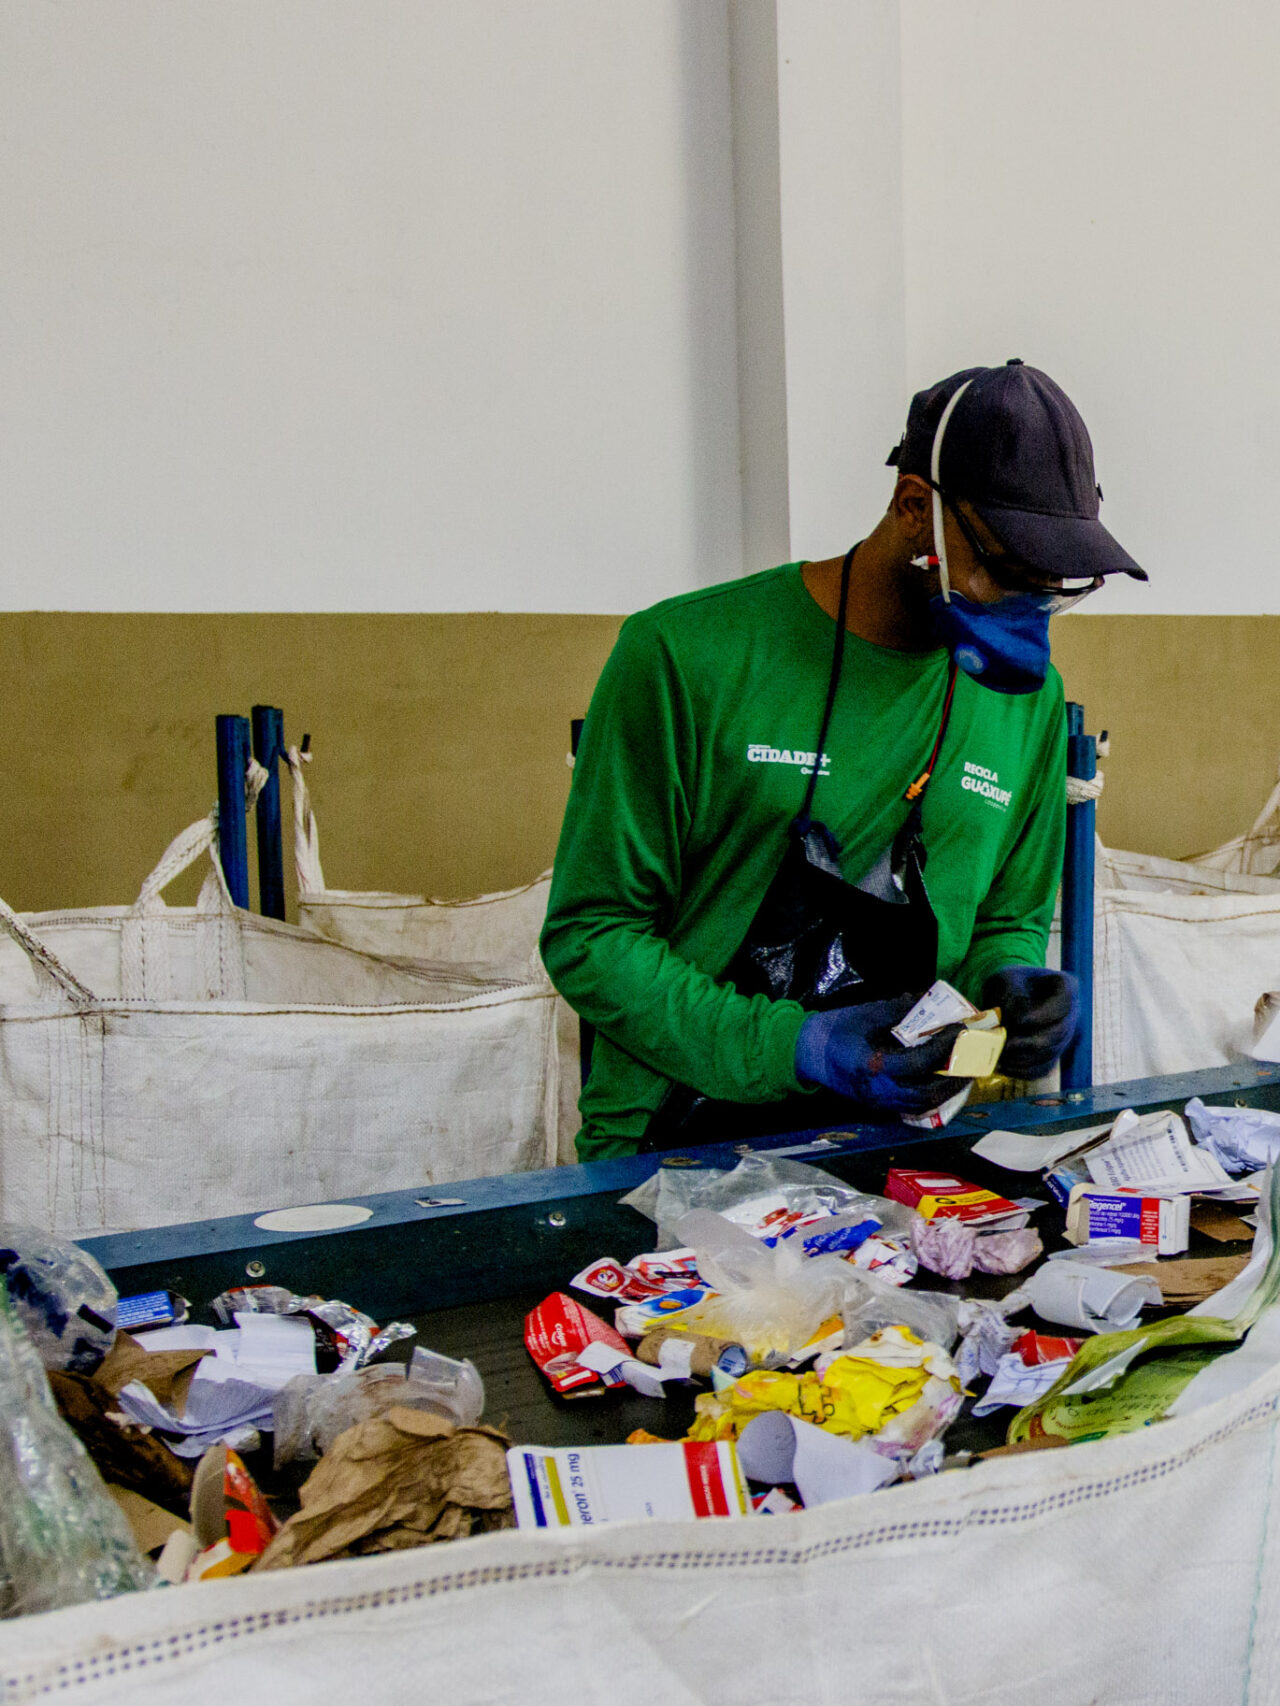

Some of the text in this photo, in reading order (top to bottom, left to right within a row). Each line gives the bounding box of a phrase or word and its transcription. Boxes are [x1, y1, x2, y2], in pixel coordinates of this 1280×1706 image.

[963, 761, 999, 783] RECICLA
[568, 1453, 580, 1473] mg
[570, 1475, 584, 1488] 25
